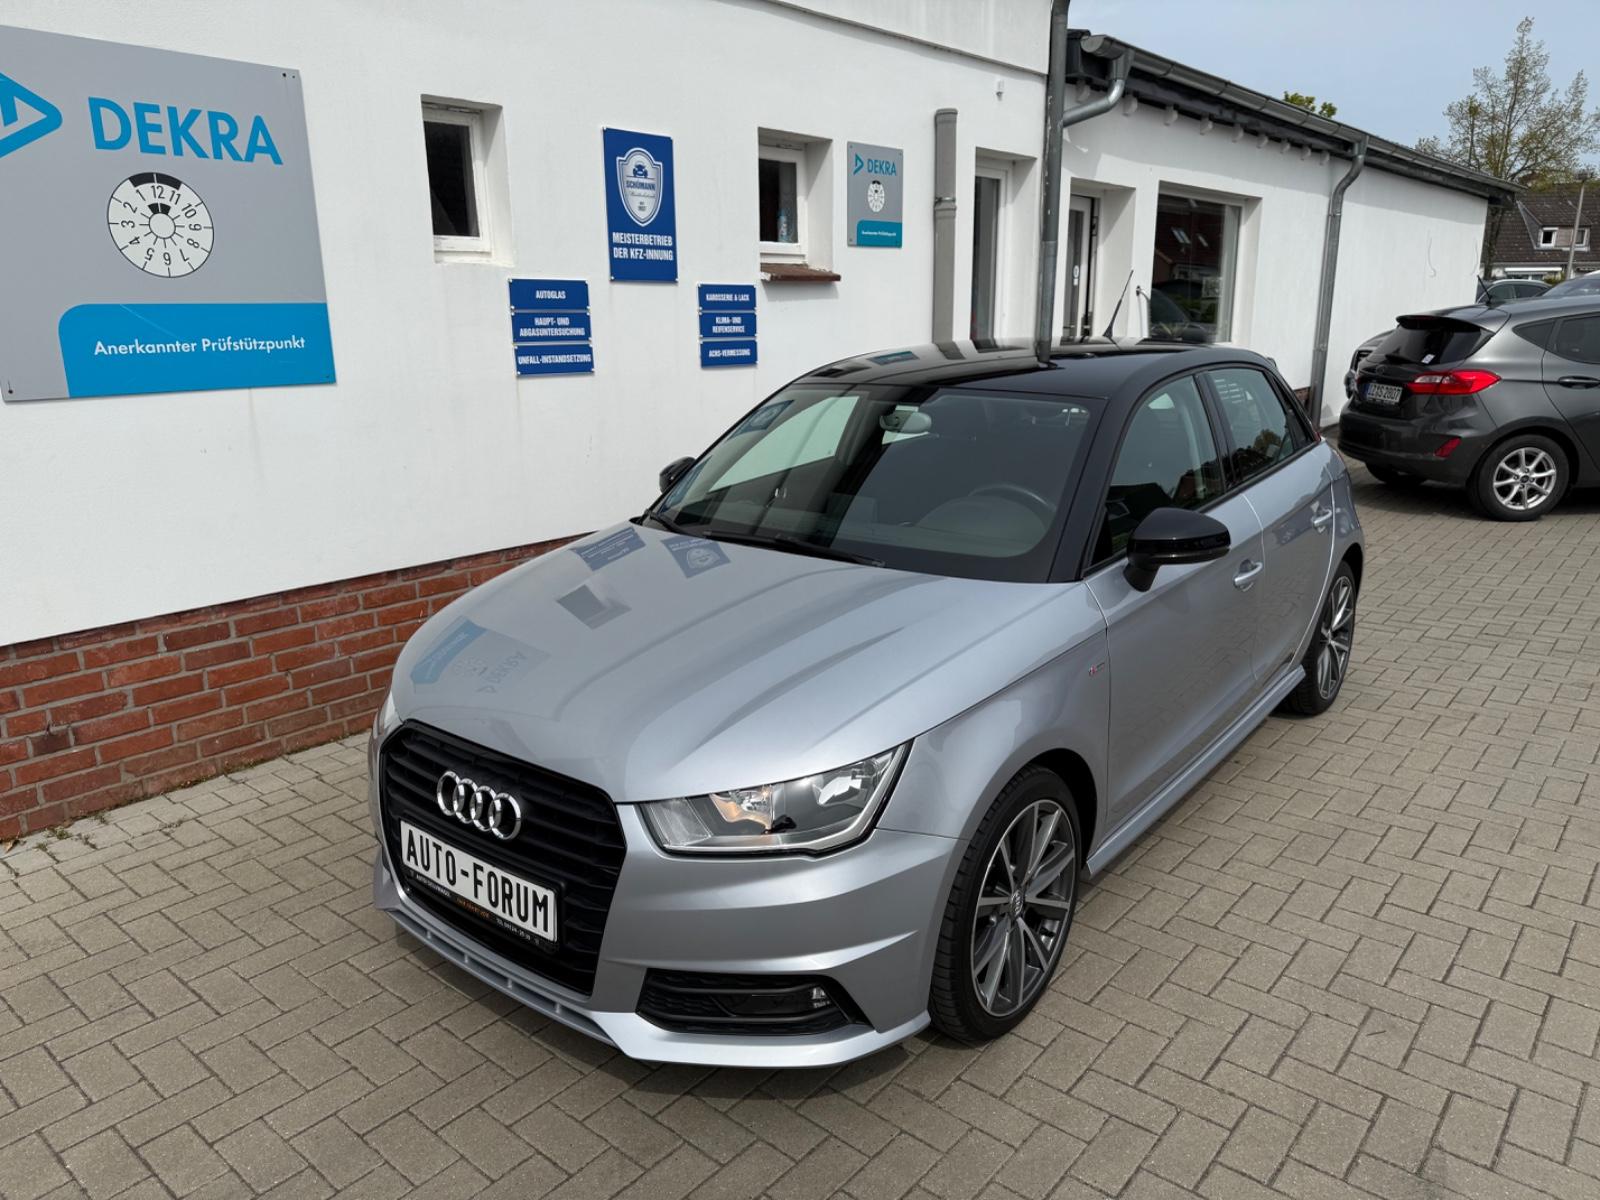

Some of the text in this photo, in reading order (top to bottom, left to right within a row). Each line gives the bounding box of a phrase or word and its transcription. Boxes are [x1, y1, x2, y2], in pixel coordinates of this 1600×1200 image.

[88, 96, 284, 165] DEKRA
[866, 158, 897, 177] DEKRA
[612, 231, 673, 246] MEISTERBETRIEB
[613, 247, 674, 261] DER KFZ-INNUNG
[535, 290, 567, 299] AUTOGLAS
[534, 317, 570, 326] HAUPT- UND
[519, 327, 586, 338] ABGASUNTERSUCHUNG
[94, 335, 306, 356] Anerkannter Prüfstützpunkt
[518, 354, 592, 365] UNFALL-INSTANDSETZUNG
[406, 828, 549, 933] AUTO-FORUM
